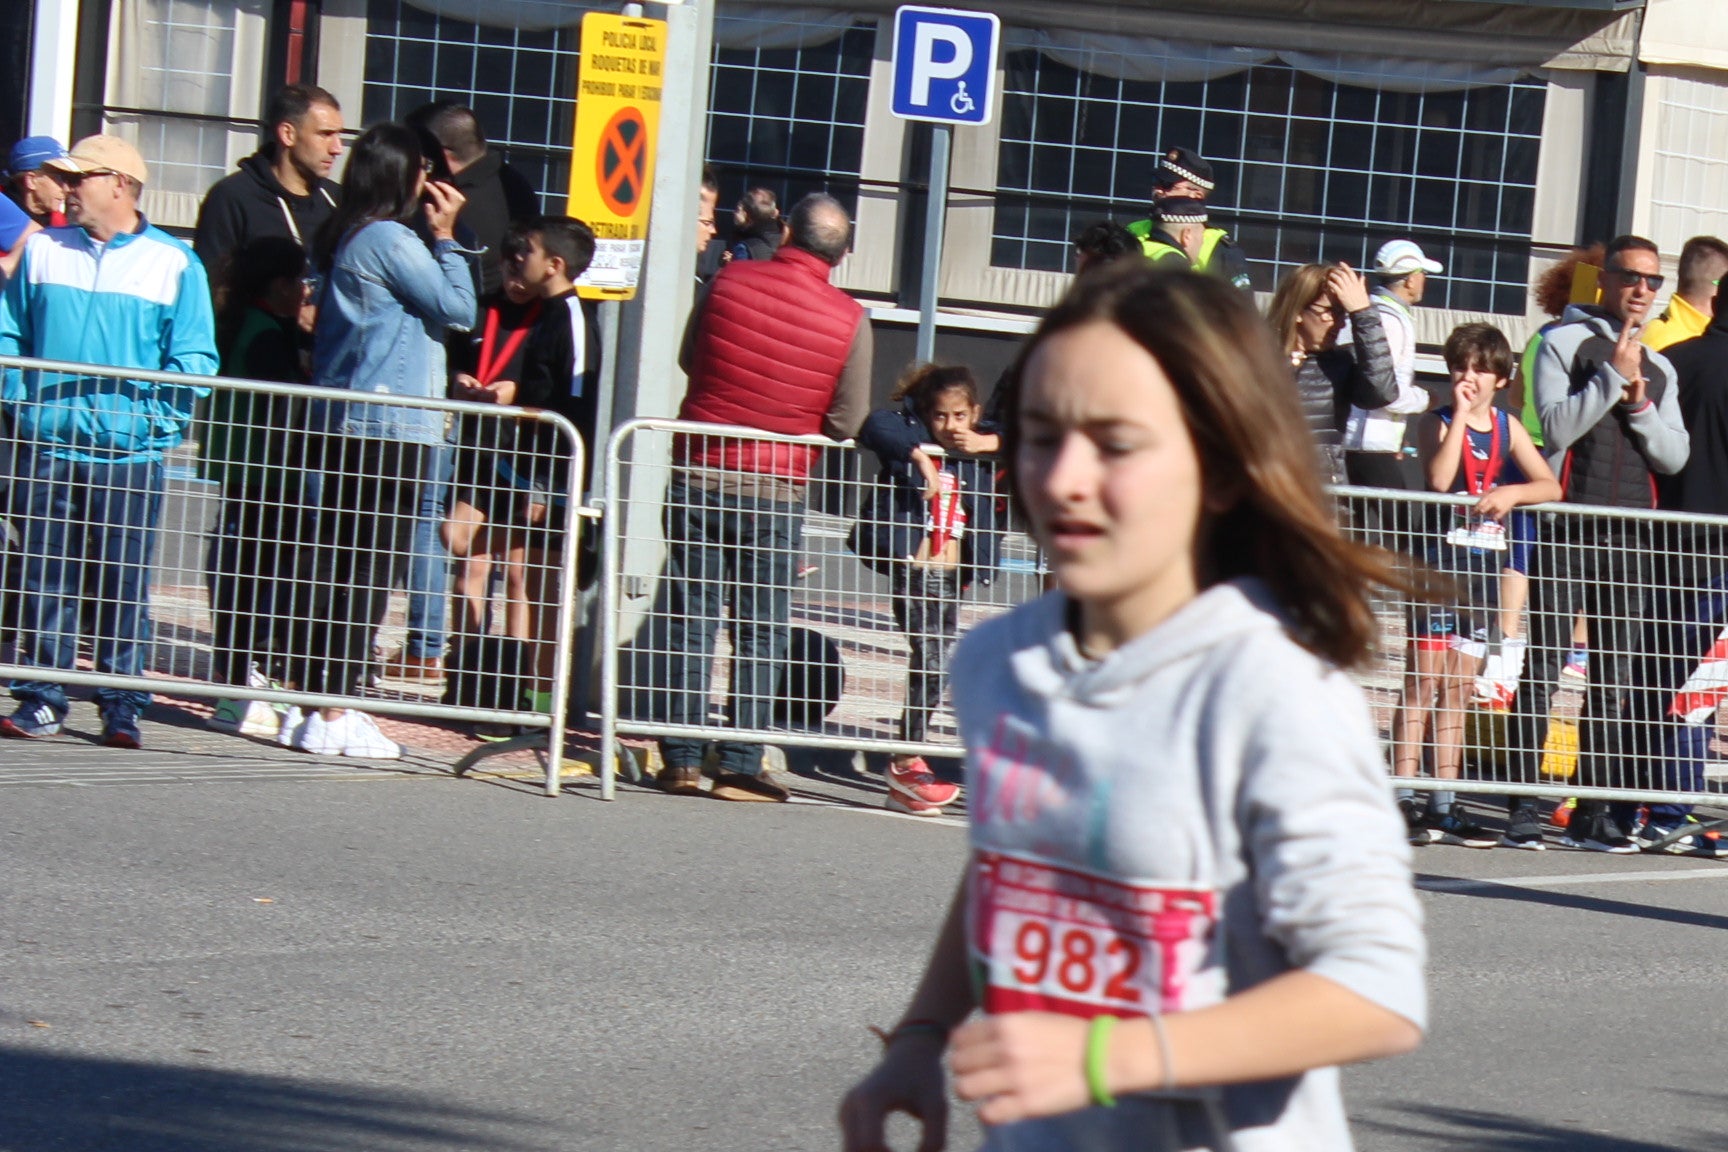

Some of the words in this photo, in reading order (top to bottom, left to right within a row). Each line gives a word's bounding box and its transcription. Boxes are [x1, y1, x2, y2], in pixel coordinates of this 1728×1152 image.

[591, 53, 636, 73] ROQUETAS
[910, 21, 973, 107] P
[1012, 921, 1142, 1002] 982
